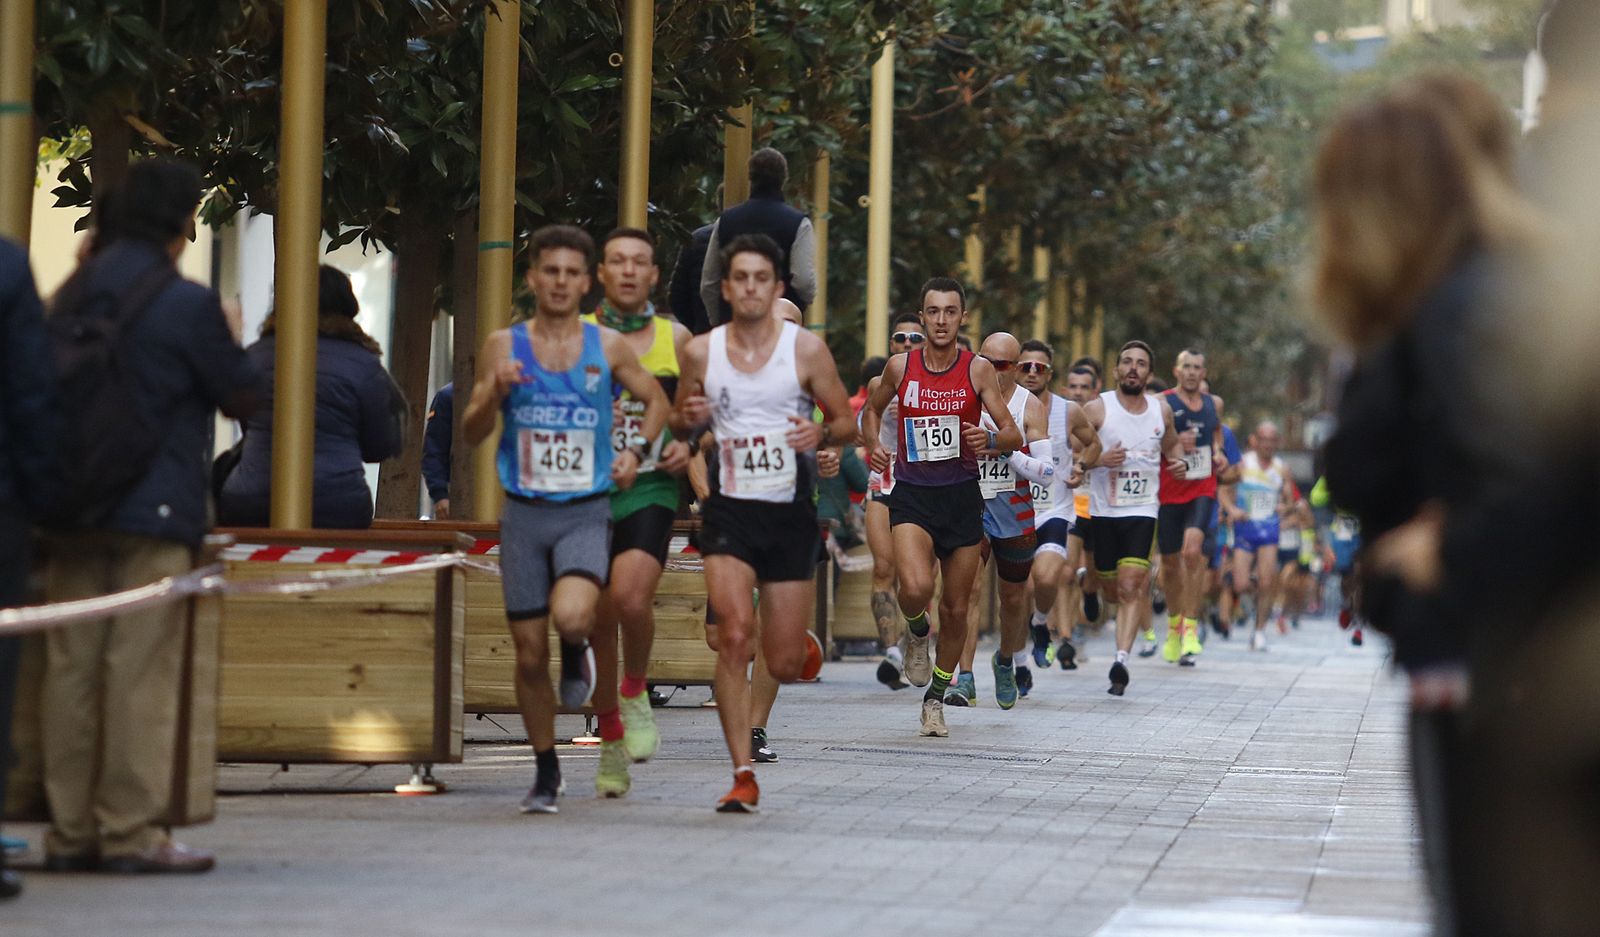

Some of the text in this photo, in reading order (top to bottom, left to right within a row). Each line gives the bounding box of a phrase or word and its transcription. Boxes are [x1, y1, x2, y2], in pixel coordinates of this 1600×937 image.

[572, 406, 599, 428] CD
[921, 427, 952, 447] 150
[540, 447, 584, 471] 462
[744, 447, 785, 473] 443
[980, 462, 1010, 480] 144
[1122, 479, 1148, 495] 427
